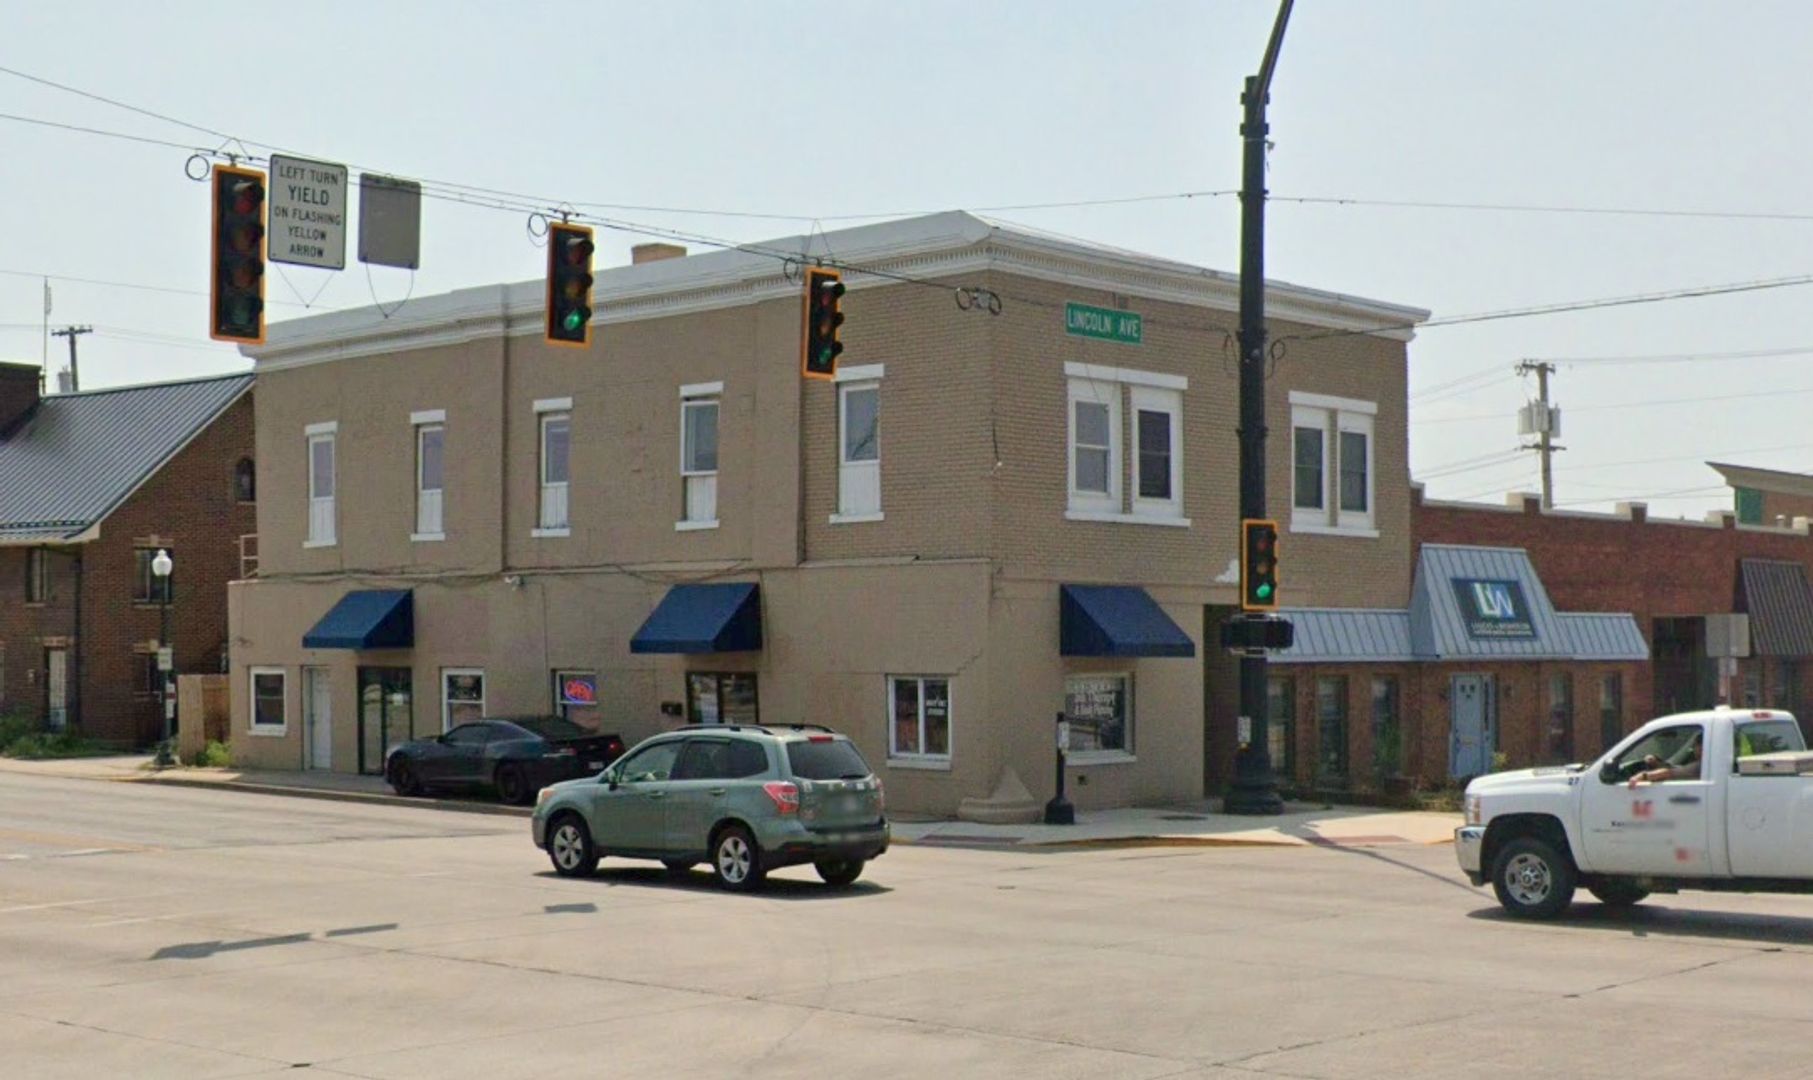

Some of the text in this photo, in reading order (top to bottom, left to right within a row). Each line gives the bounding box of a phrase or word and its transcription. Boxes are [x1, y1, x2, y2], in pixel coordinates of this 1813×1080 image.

[279, 165, 339, 185] LEFT TURN
[288, 185, 330, 206] YIELD
[274, 206, 341, 226] ON FLASHING
[288, 225, 327, 241] YELLOW
[289, 244, 325, 258] ARROW
[1067, 307, 1139, 338] LINCOLN AVE
